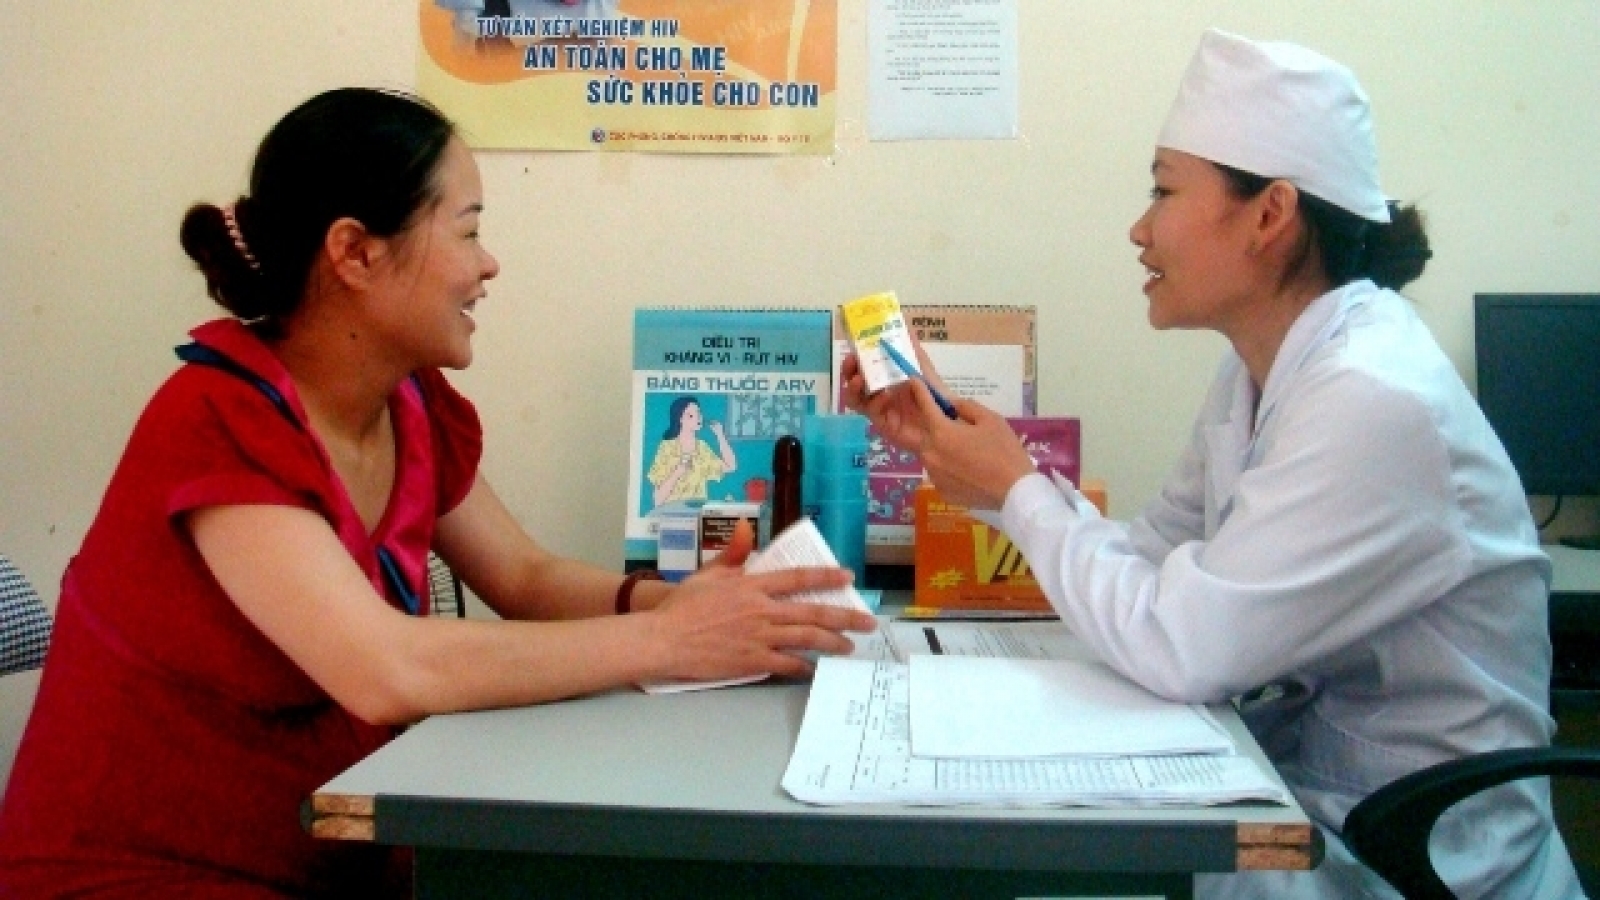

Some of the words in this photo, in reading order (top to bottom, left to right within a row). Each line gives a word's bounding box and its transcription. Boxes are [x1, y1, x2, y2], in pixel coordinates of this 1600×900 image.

[542, 15, 573, 36] XÉT
[579, 16, 646, 40] NGHIỆM
[652, 19, 679, 37] HIV
[525, 46, 557, 69] AN
[565, 40, 627, 70] TOÀN
[635, 46, 682, 71] CHO
[692, 46, 726, 76] MẸ
[587, 73, 634, 105] SỨC
[642, 72, 704, 106] KHỎE
[714, 81, 761, 107] CHO
[769, 83, 819, 108] CON
[717, 351, 731, 364] VI
[775, 353, 798, 366] HIV
[704, 372, 769, 391] THUỐC
[775, 379, 816, 393] ARV
